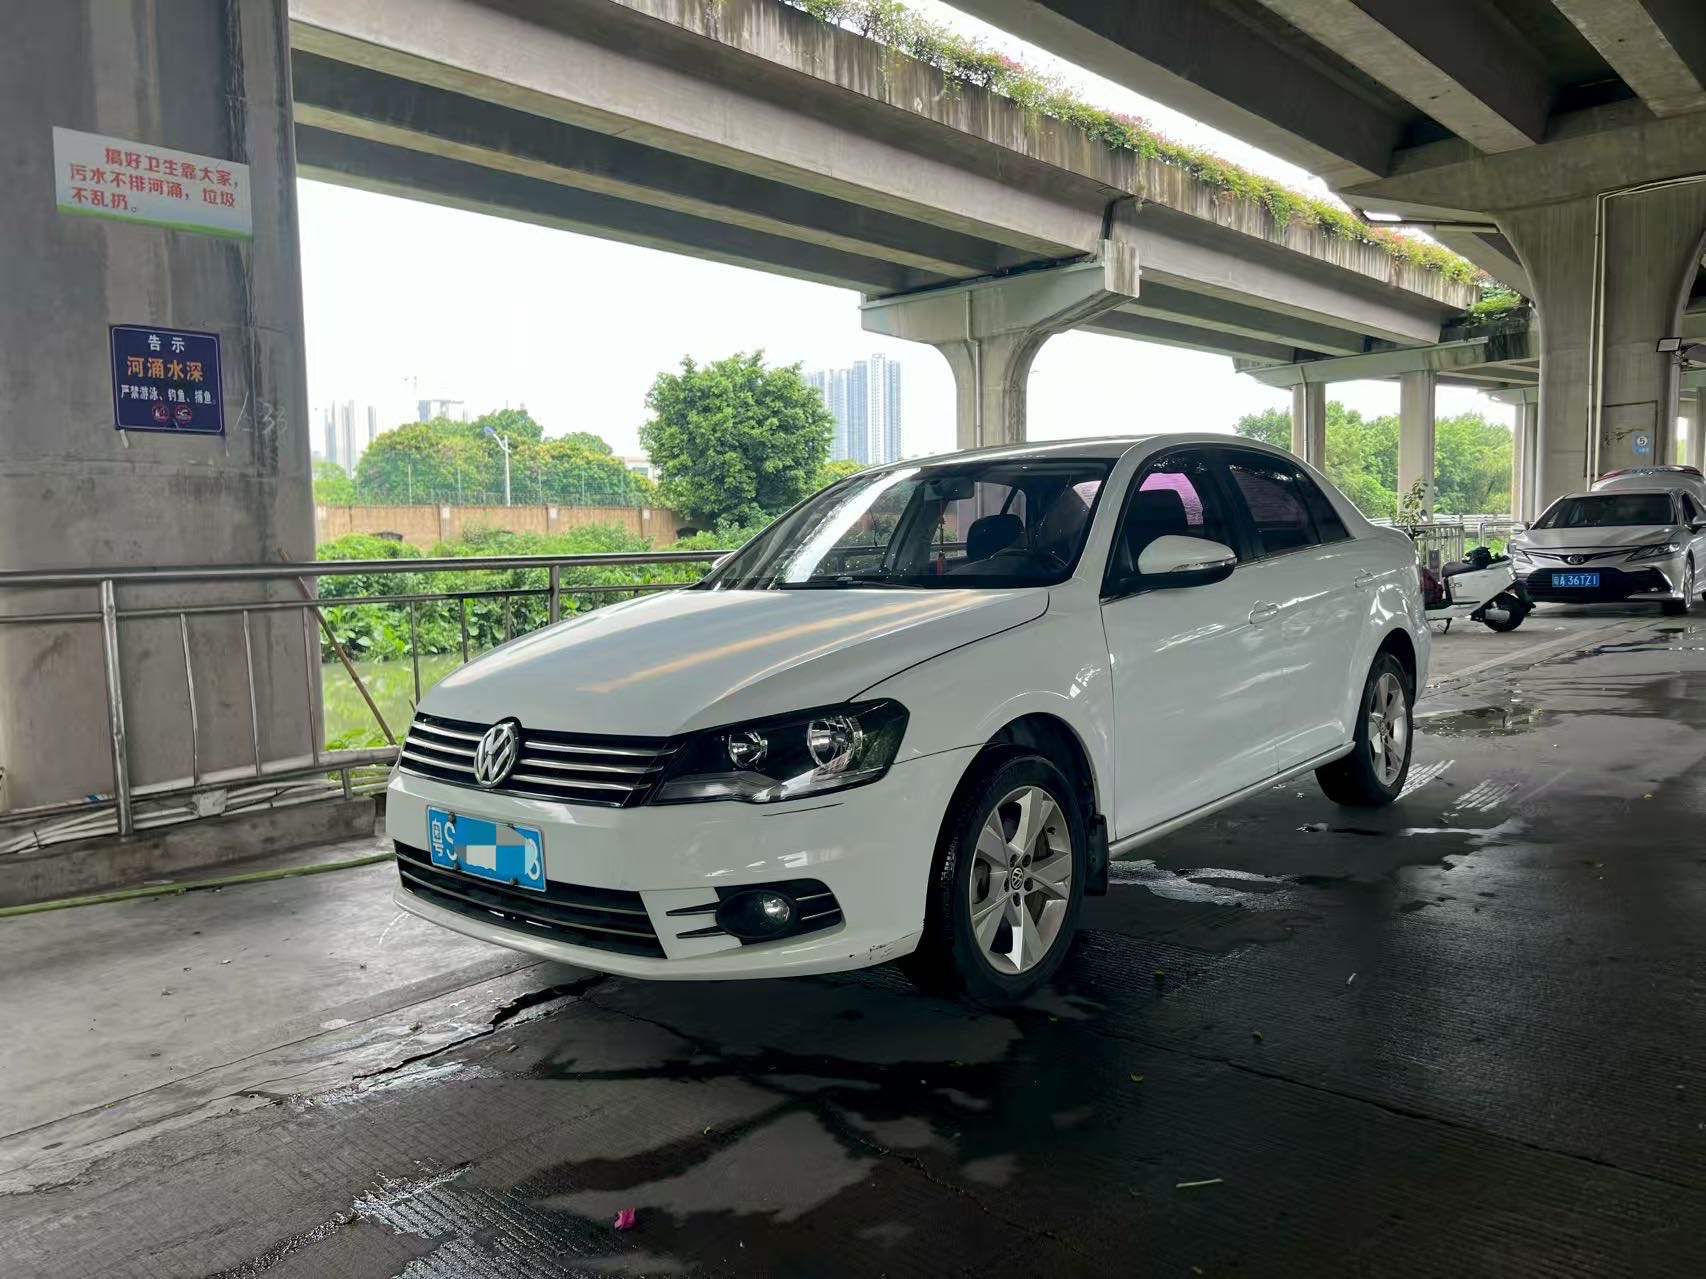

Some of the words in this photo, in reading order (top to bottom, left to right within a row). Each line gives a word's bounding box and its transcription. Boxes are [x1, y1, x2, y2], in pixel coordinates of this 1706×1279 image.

[148, 334, 185, 353] 告示
[127, 355, 203, 382] 河涌水深
